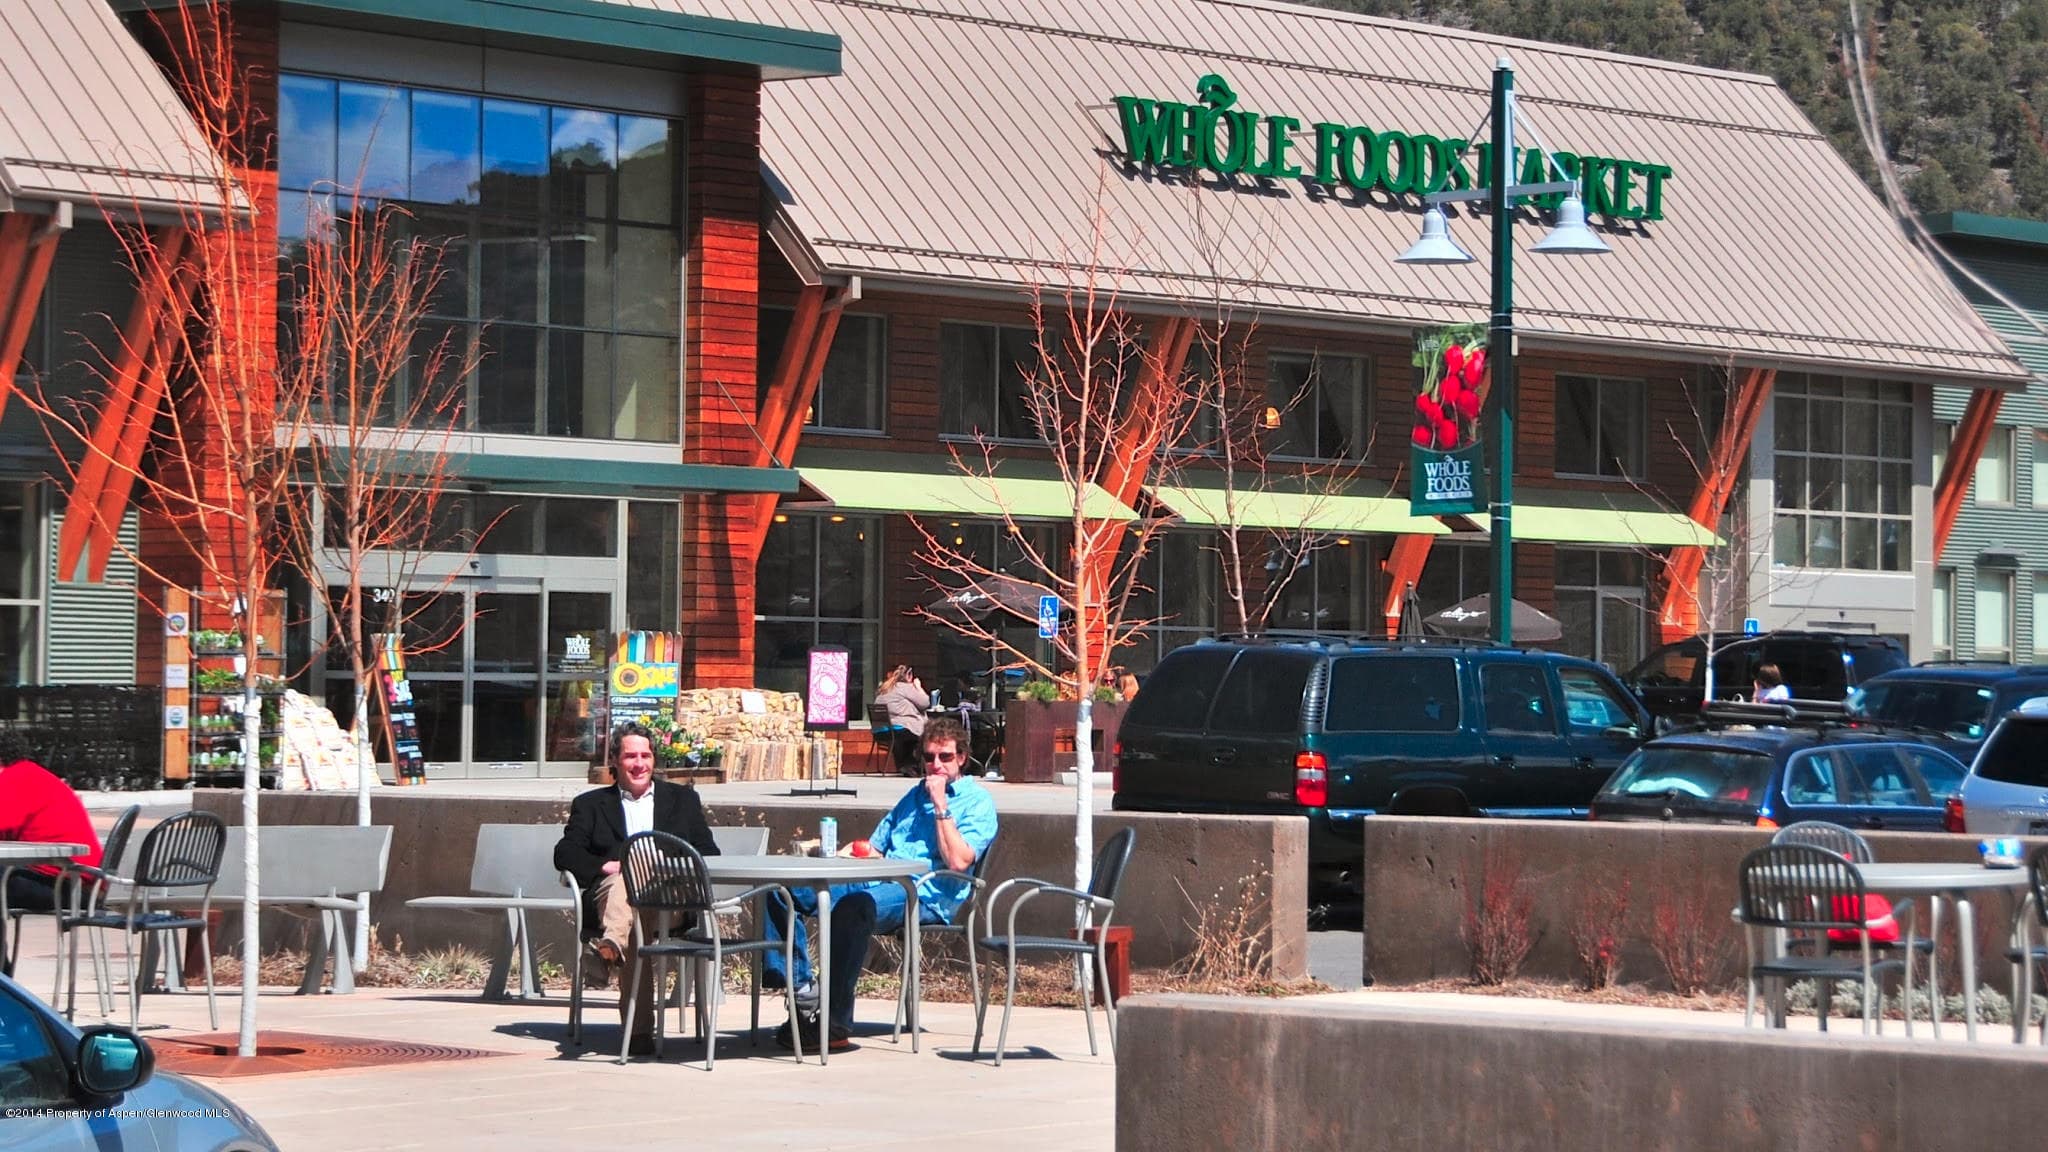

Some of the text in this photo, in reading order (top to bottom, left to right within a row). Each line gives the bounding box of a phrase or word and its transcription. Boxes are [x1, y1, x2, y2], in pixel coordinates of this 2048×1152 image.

[1115, 94, 1302, 180] WHOLE
[1313, 121, 1471, 196] FOODS
[1424, 460, 1472, 477] WHOLE
[1427, 476, 1472, 492] FOODS
